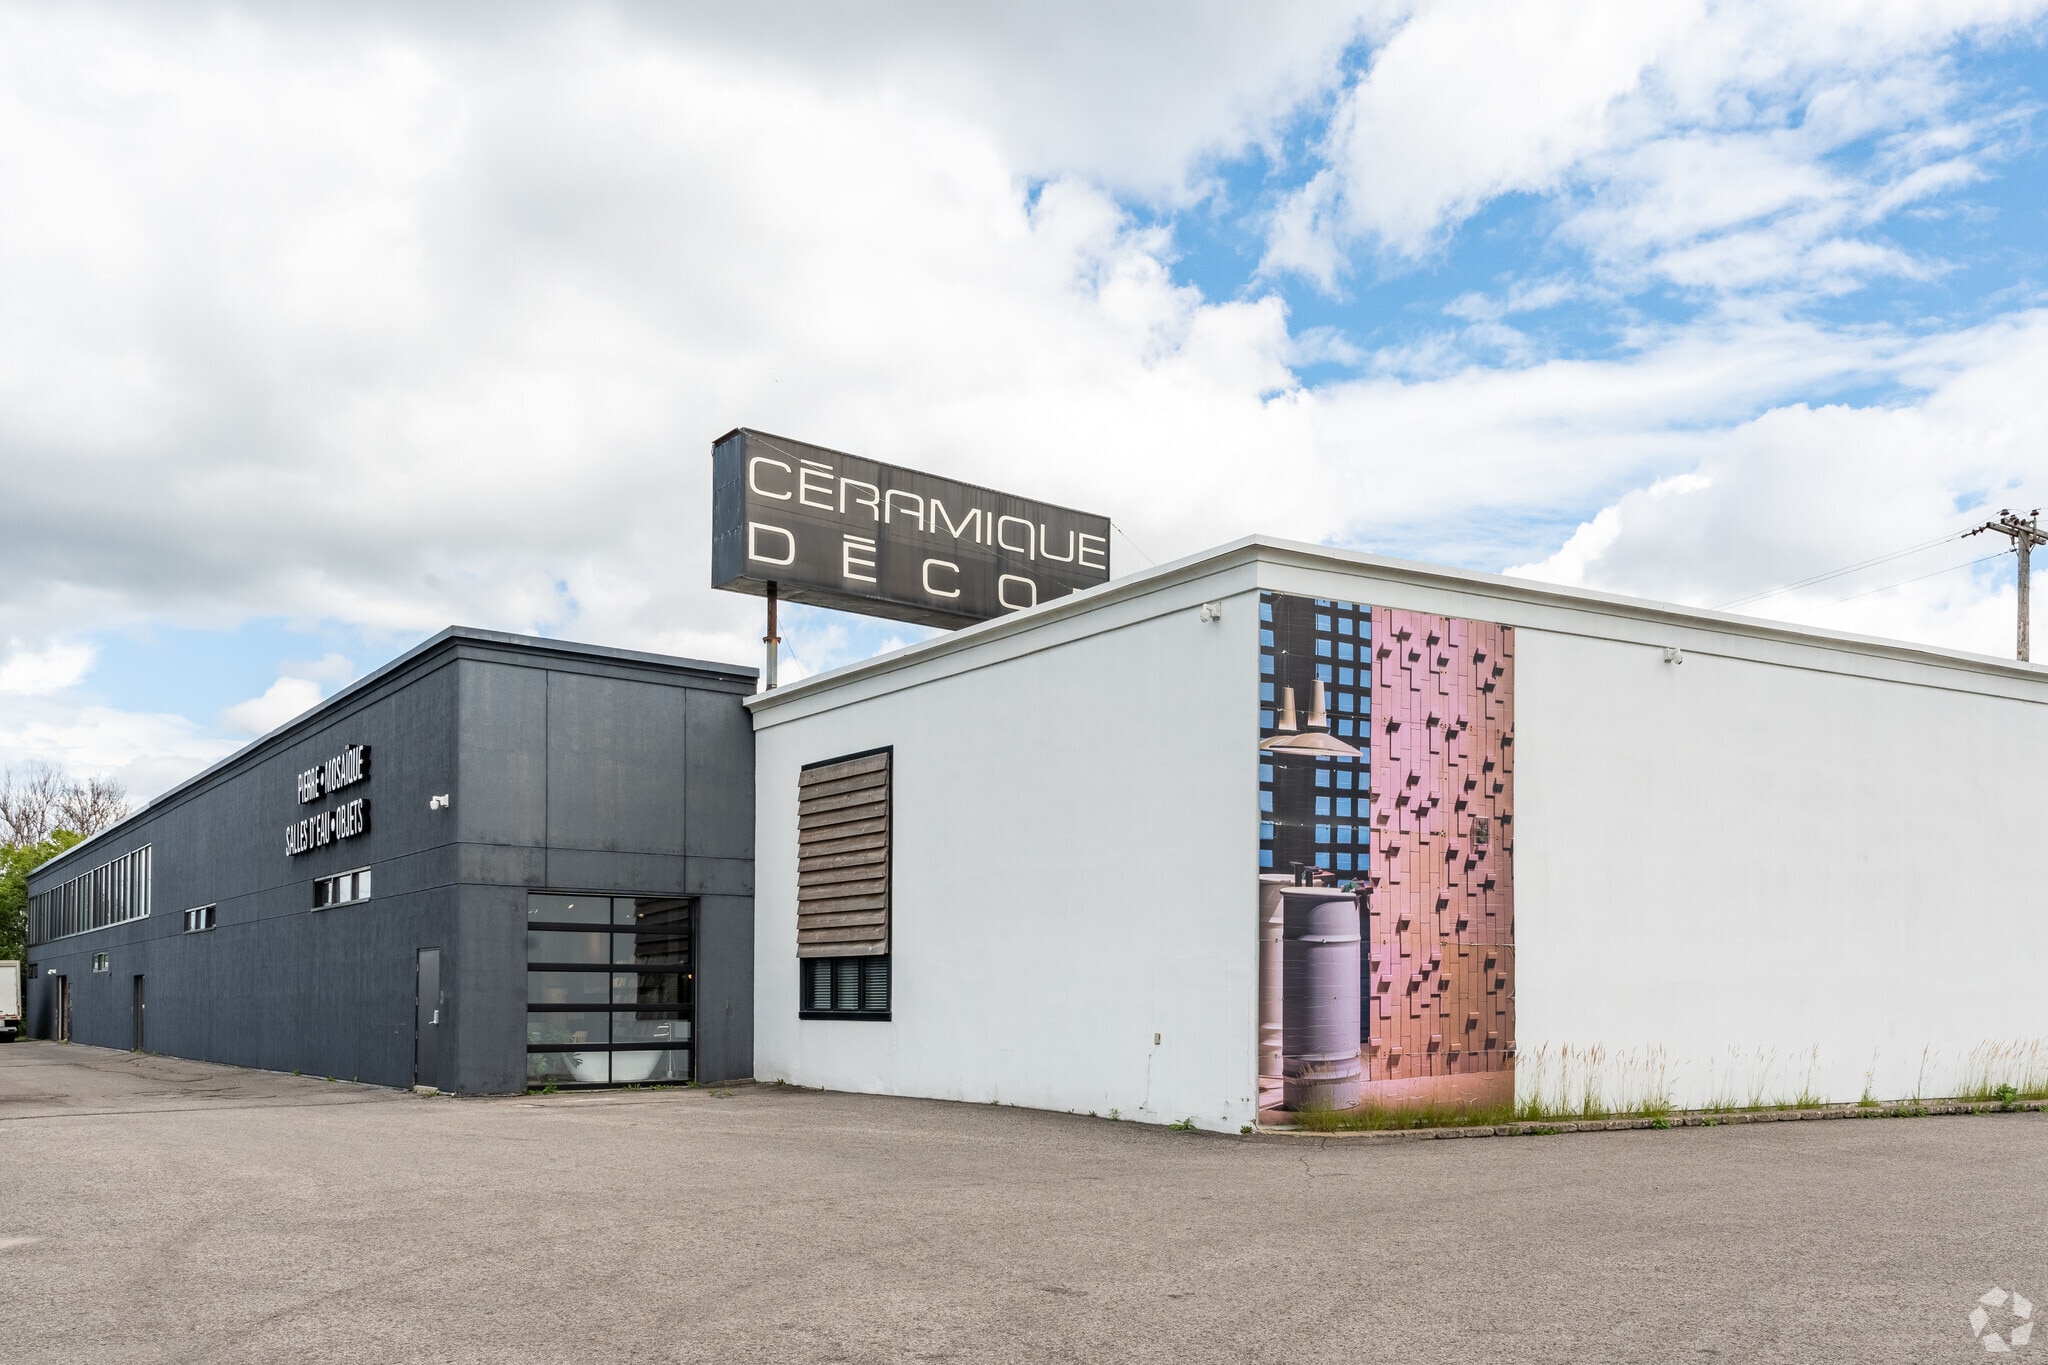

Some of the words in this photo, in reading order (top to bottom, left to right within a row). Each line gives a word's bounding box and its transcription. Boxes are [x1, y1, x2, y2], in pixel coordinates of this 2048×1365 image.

[748, 521, 1084, 611] DÉCO
[285, 819, 308, 857] SALLES
[309, 810, 330, 849] D'EAU
[336, 798, 363, 840] OBJETS
